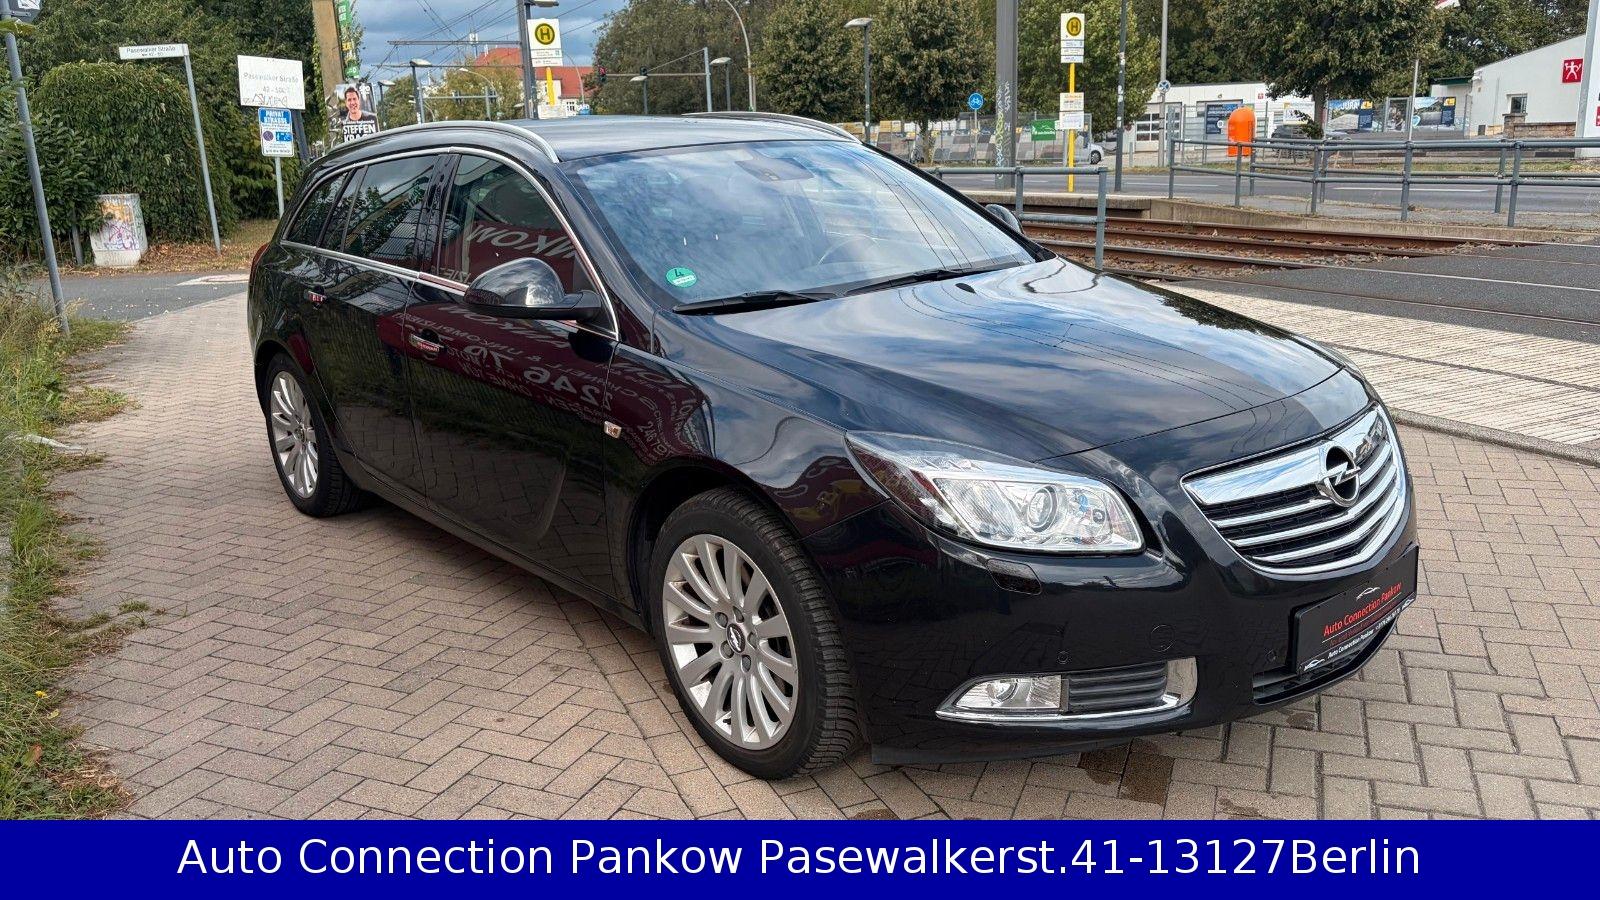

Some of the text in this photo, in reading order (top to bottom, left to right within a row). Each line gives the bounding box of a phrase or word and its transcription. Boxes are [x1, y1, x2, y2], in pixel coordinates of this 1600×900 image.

[343, 124, 377, 135] STEFFEN
[674, 268, 685, 277] 4
[1323, 620, 1343, 637] Auto
[1344, 599, 1381, 627] Connection
